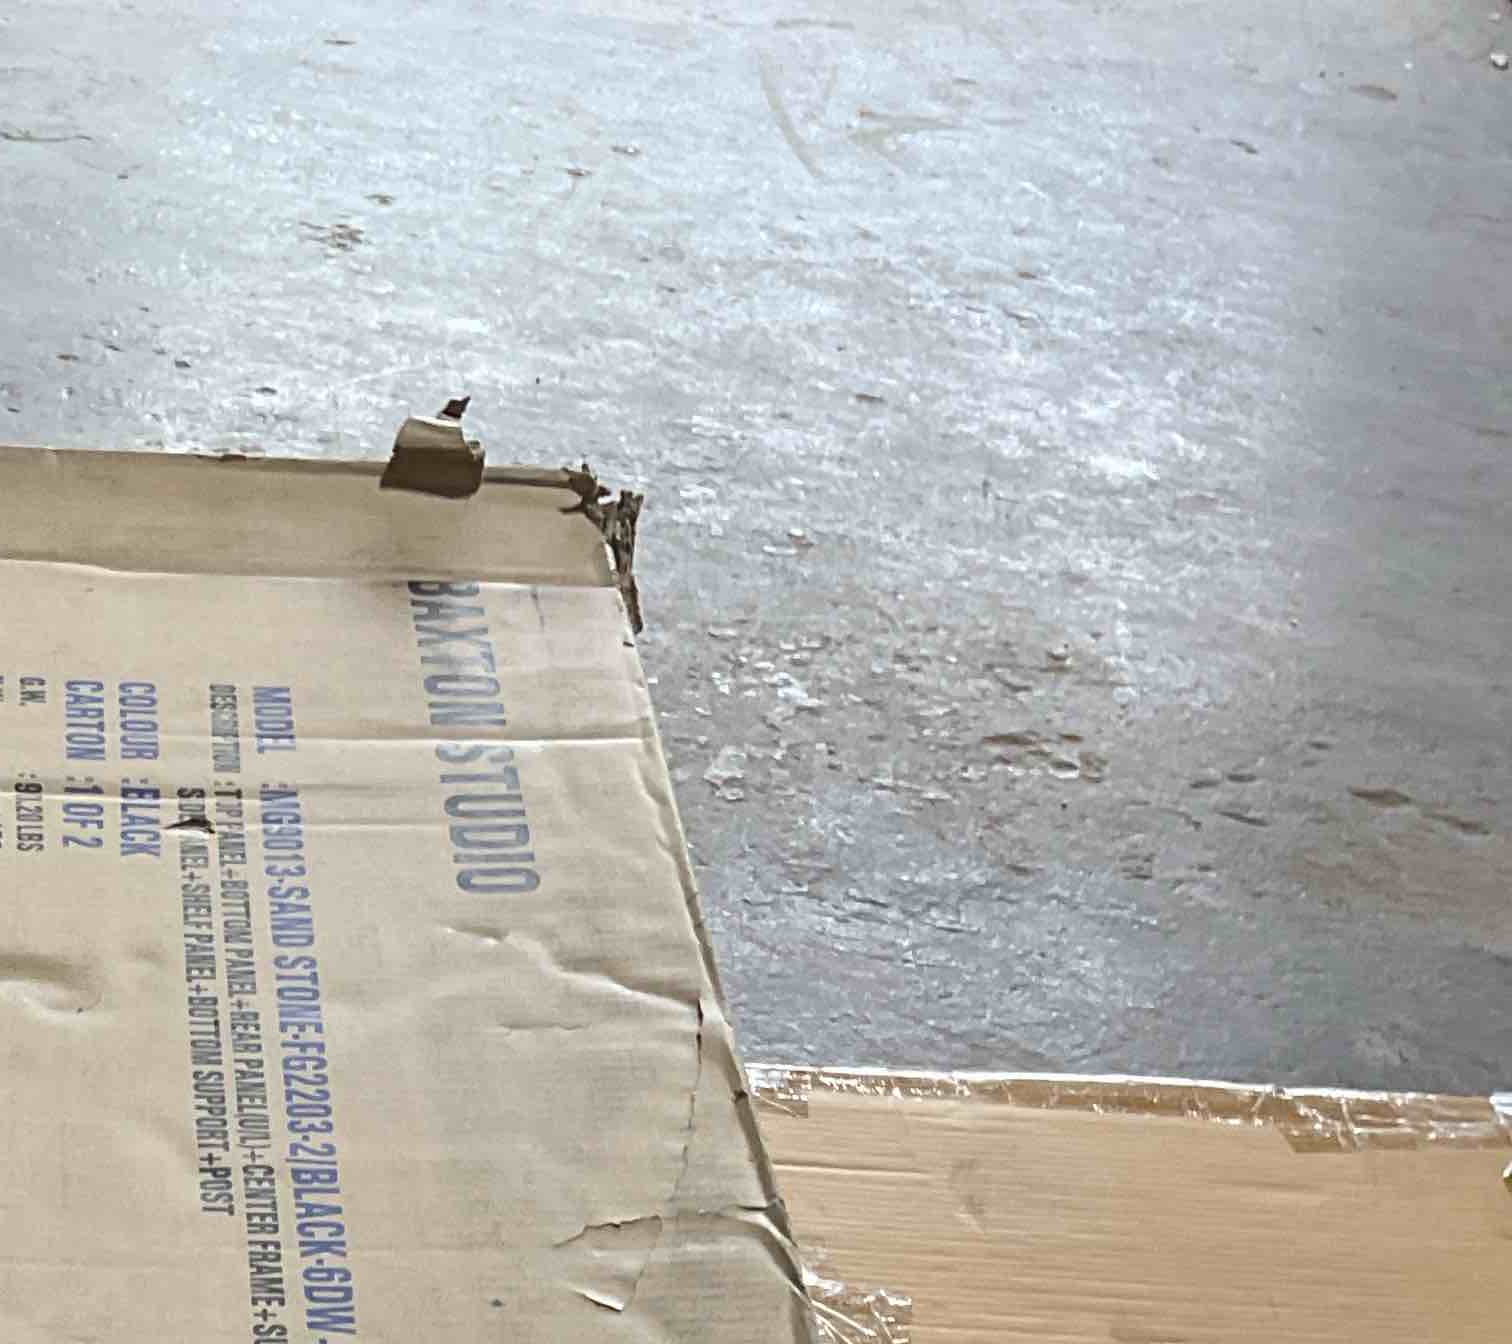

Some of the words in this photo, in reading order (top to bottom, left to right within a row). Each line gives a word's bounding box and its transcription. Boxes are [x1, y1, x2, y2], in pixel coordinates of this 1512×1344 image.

[19, 676, 46, 706] G.W.
[408, 581, 507, 726] BAXTON
[65, 680, 106, 761] CARTON
[118, 681, 159, 761] COLOUR
[252, 687, 297, 755] MODEL
[16, 825, 44, 852] LBS
[62, 801, 104, 830] OF
[62, 834, 103, 849] 2
[435, 743, 541, 894] STUDIO
[184, 934, 223, 1066] PANEL+BOTTOM
[192, 1071, 235, 1217] SUPPORT+POST
